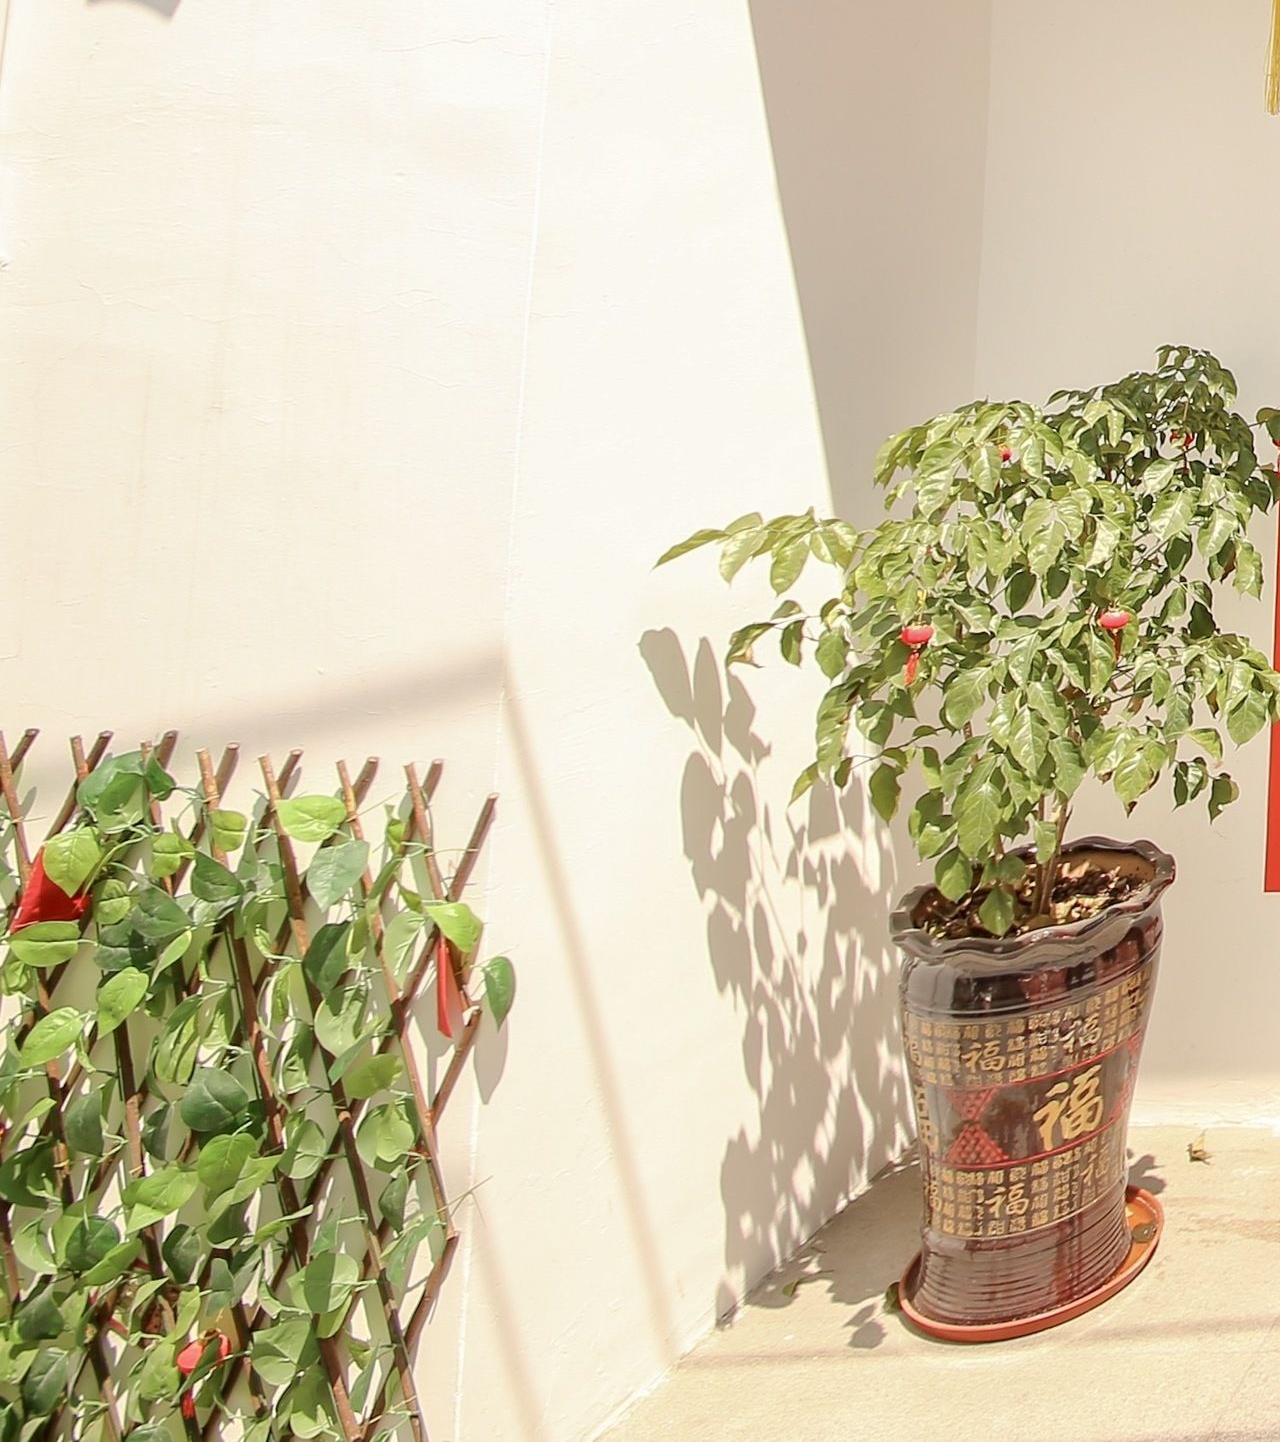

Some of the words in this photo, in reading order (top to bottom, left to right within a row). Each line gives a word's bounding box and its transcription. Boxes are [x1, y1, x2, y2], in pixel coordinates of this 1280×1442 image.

[963, 1040, 1006, 1073] 福
[1033, 1064, 1105, 1152] 福
[986, 1184, 1030, 1218] 福
